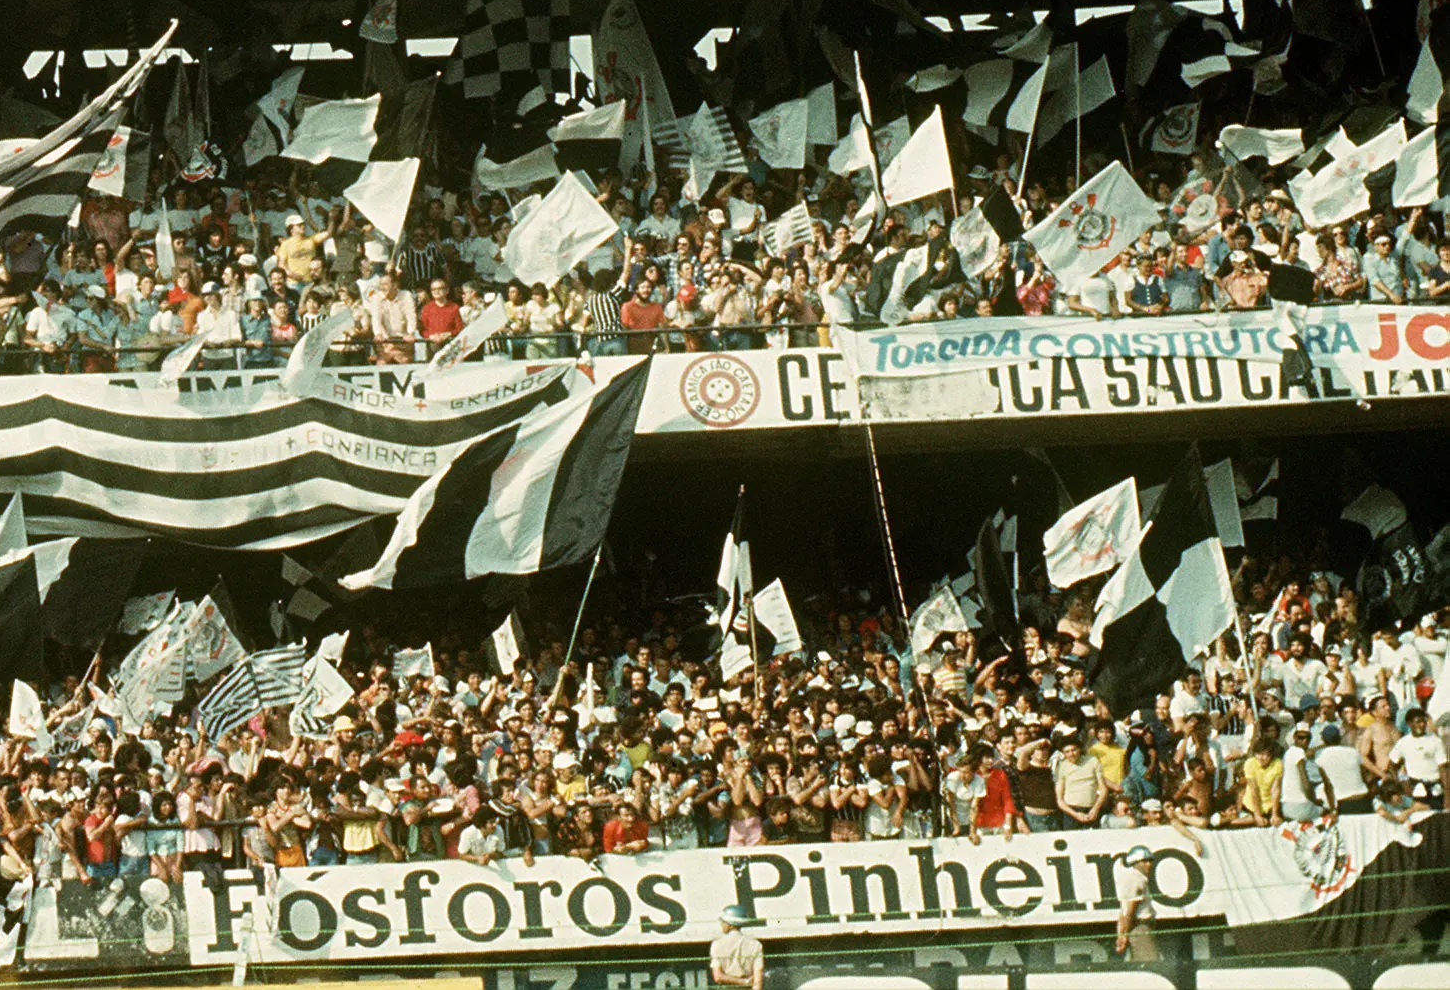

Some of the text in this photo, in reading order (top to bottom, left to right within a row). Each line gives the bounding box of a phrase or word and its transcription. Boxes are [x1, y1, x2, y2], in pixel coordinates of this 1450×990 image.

[868, 329, 1021, 372] TORCIDA
[332, 383, 397, 410] AMOR
[203, 869, 688, 953] Fósforos
[722, 839, 1205, 928] Pinheiro
